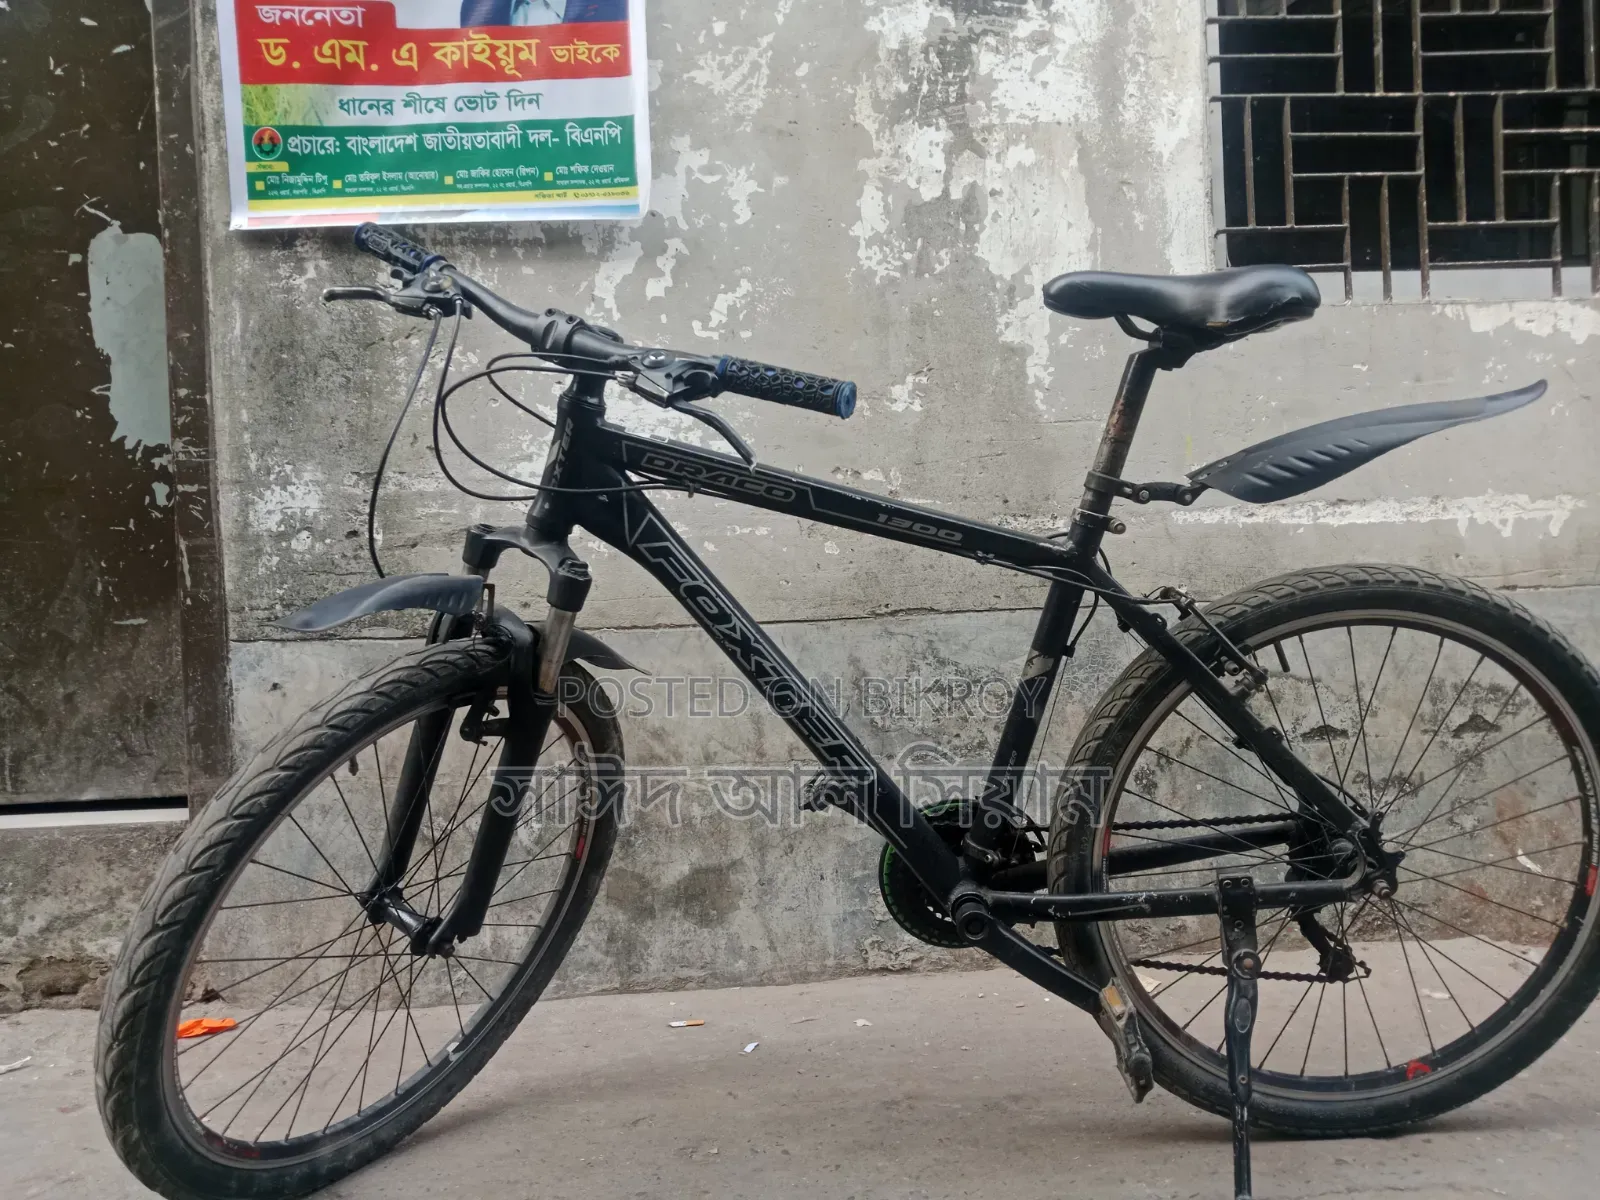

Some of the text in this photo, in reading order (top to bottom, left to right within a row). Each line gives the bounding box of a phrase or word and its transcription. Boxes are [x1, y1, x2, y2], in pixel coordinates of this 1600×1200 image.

[255, 5, 366, 28] জননেতা
[257, 38, 300, 69] ড.
[314, 39, 378, 71] এম.
[392, 42, 418, 72] এ
[549, 38, 621, 65] ভাইকে
[338, 88, 544, 116] ধানের শীষে ভোট দিন
[287, 134, 341, 156] প্রচারে:
[344, 132, 419, 156] বাংলাদেশ
[422, 123, 523, 152] জাতীয়তাবাদী
[565, 120, 623, 147] বিএনপি
[641, 454, 796, 502] DRACO
[876, 513, 964, 542] 1300
